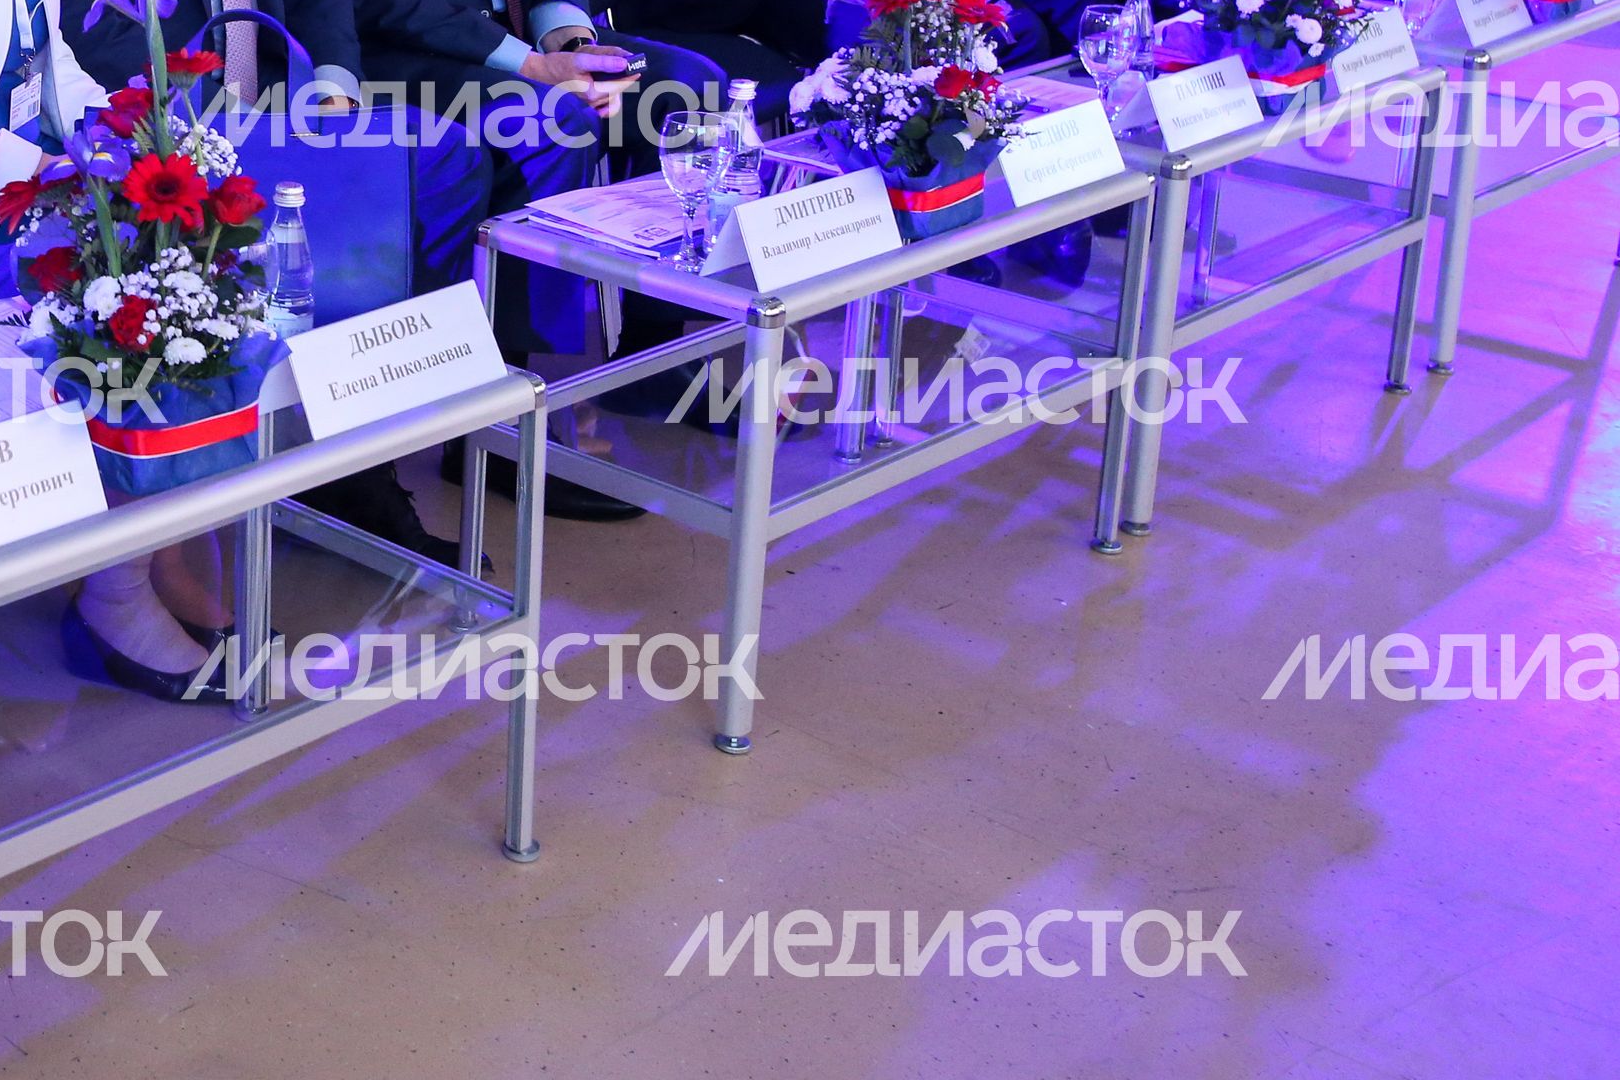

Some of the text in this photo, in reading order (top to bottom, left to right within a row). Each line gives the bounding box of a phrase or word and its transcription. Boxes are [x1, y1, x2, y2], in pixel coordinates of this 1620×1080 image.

[774, 186, 856, 229] ДМИТРИЕВ
[761, 214, 883, 260] Владимир Александрович
[348, 311, 433, 358] ДЫБОВА
[328, 342, 473, 402] Елена Николаевна
